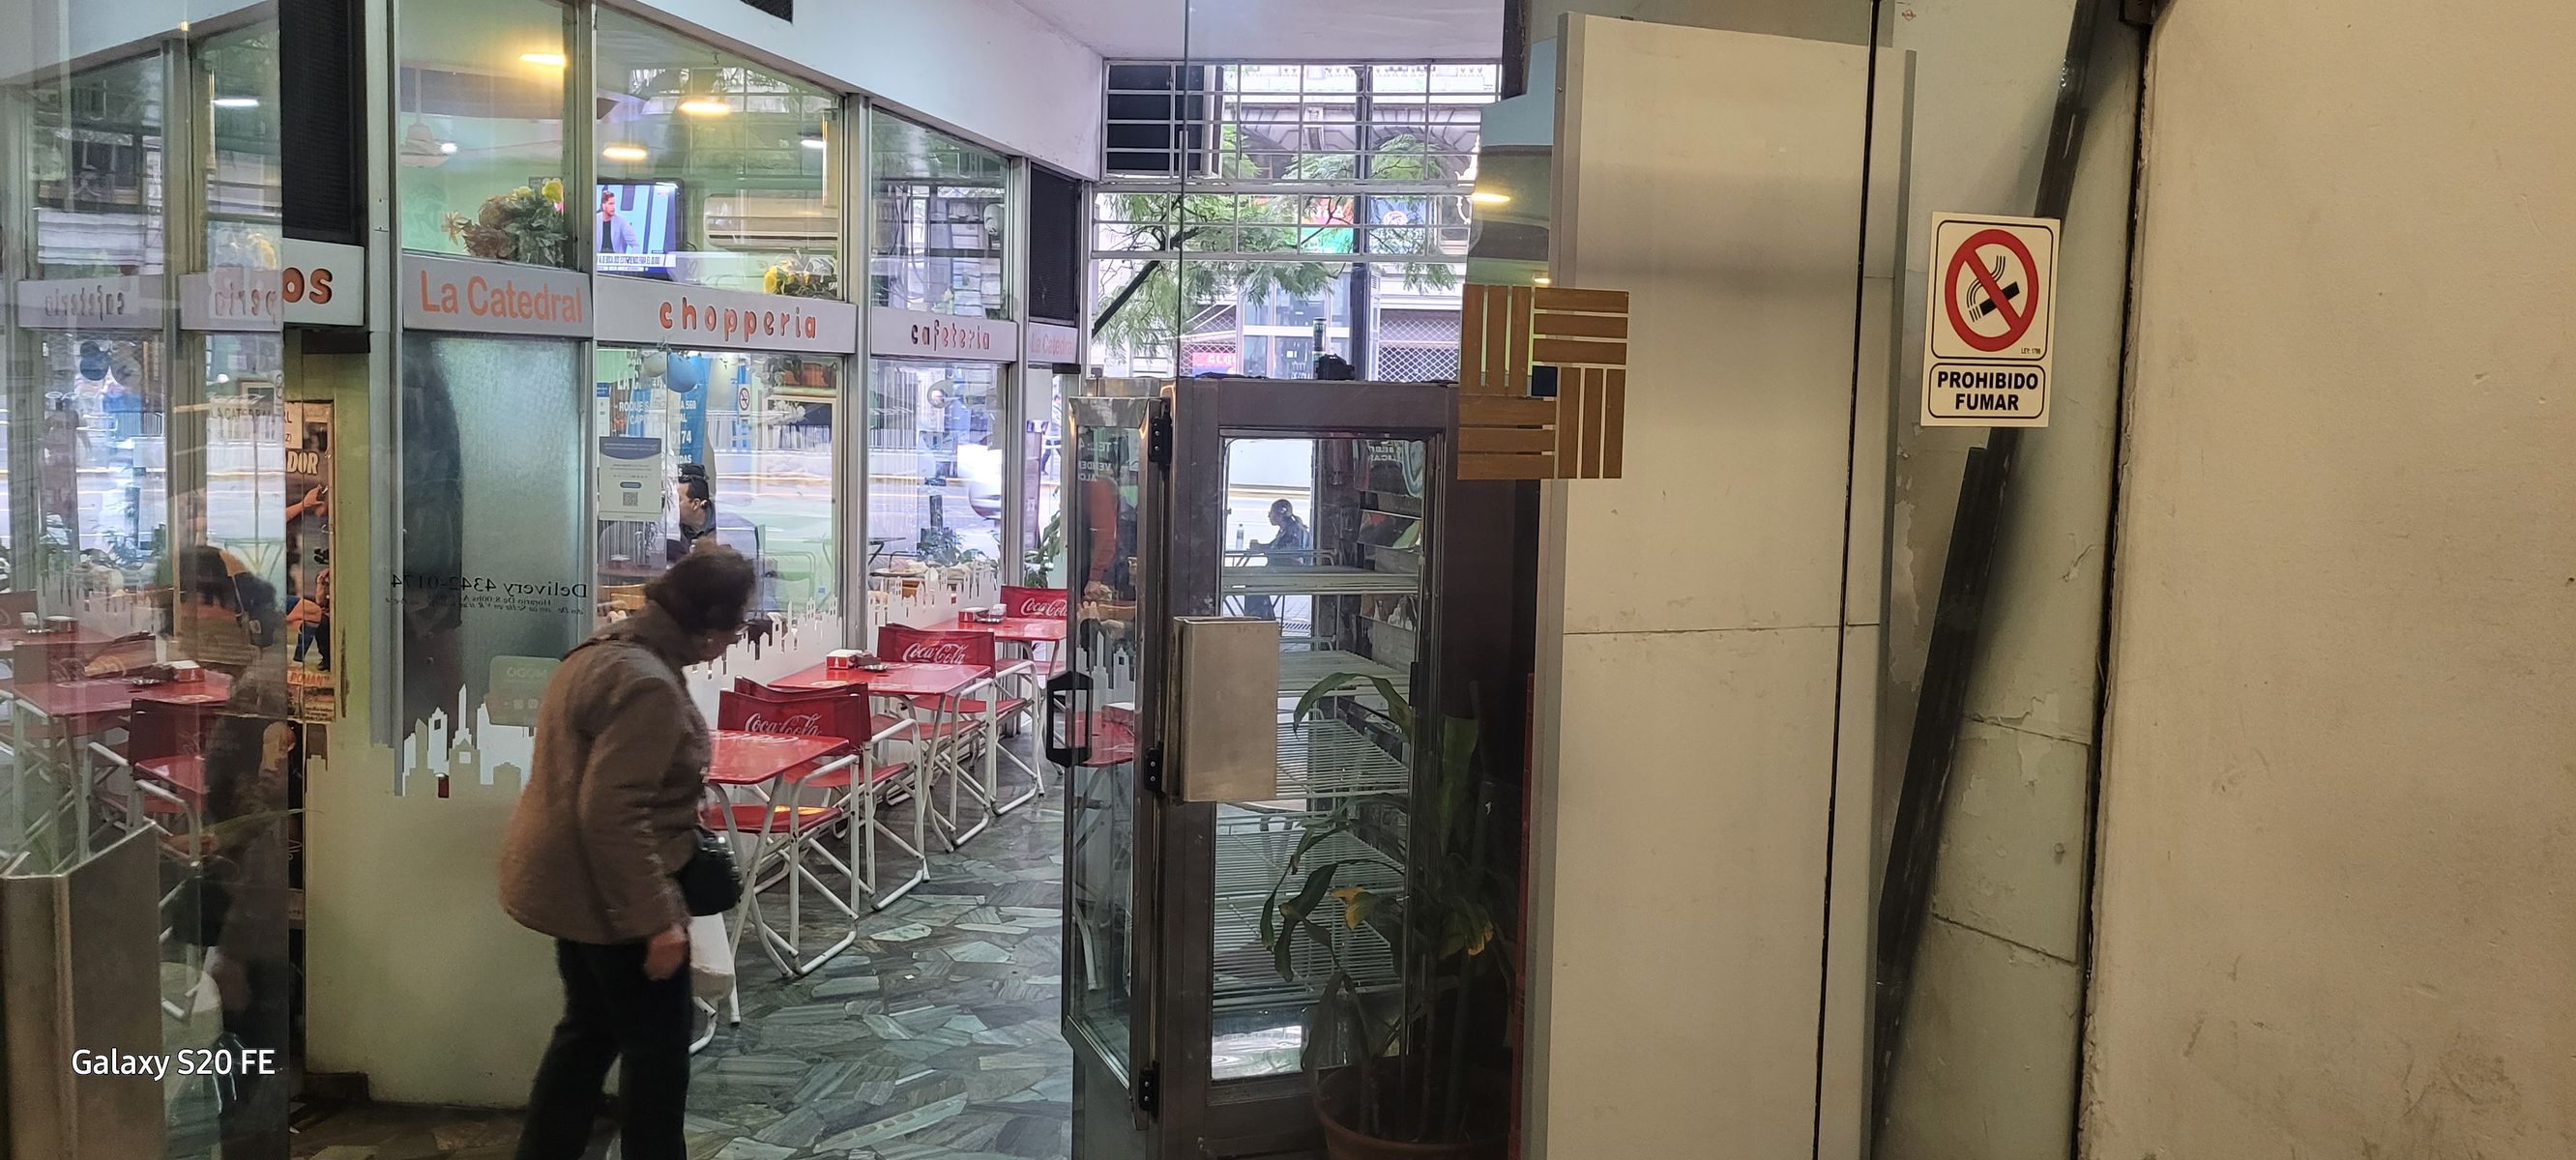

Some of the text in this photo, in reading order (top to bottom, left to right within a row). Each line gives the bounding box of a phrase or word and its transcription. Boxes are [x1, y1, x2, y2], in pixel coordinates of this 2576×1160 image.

[421, 271, 582, 324] La Catedral
[659, 296, 817, 343] chopperia
[911, 319, 990, 351] cafeteria
[1937, 370, 2039, 390] PROHIBIDO
[1955, 392, 2019, 411] FUMAR
[903, 642, 968, 664] Coca-Cola
[746, 712, 822, 736] Coca-Cola
